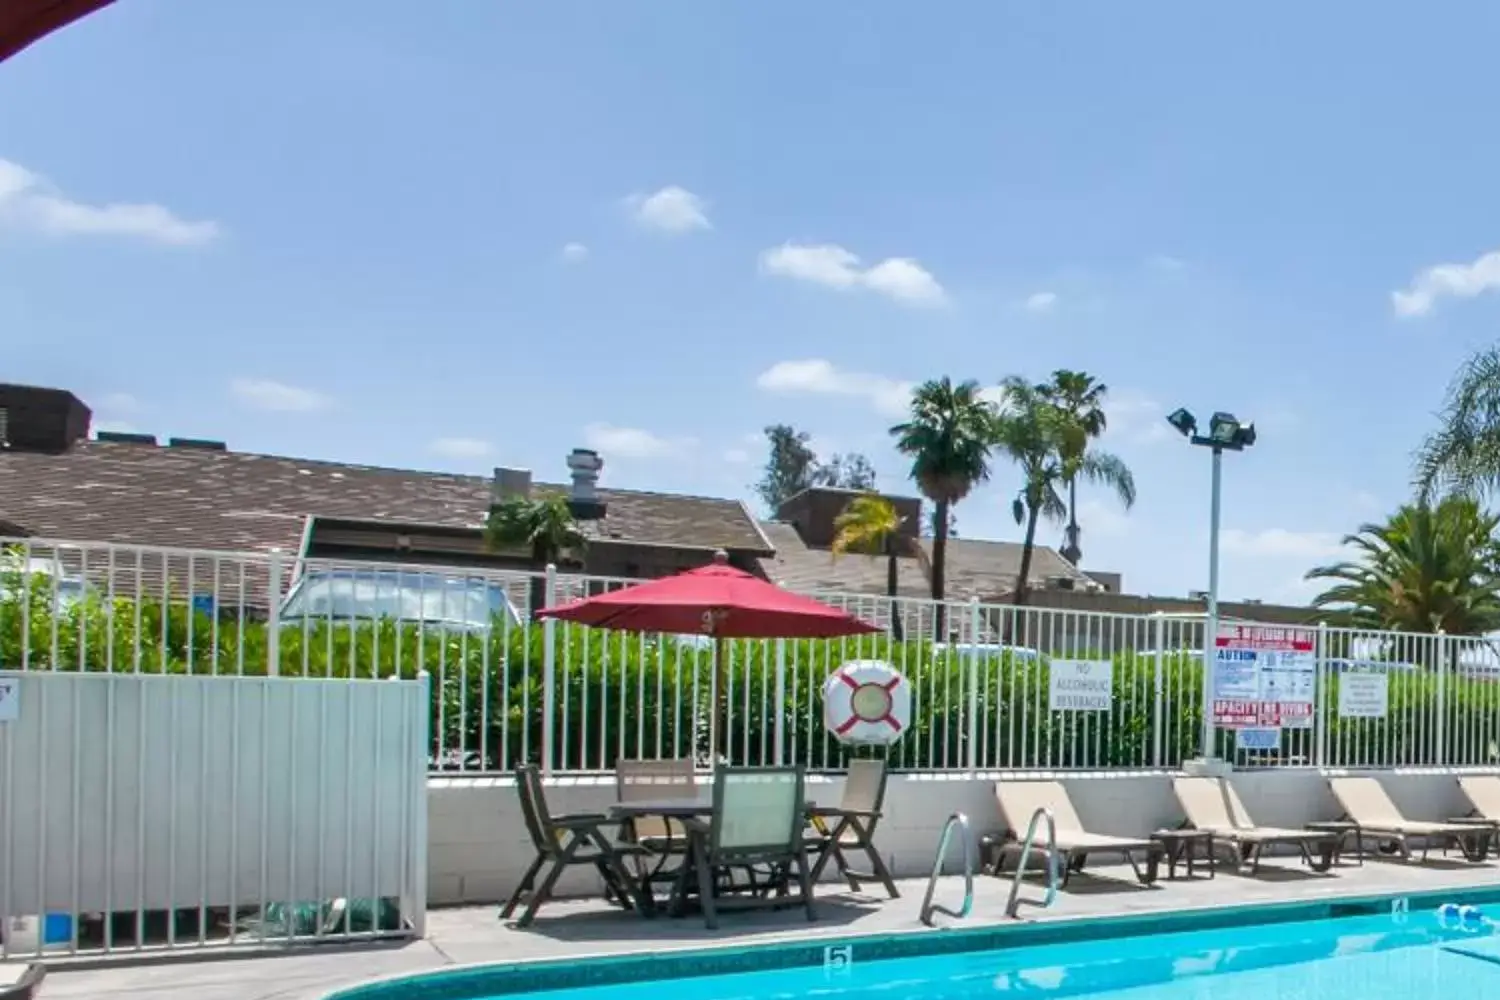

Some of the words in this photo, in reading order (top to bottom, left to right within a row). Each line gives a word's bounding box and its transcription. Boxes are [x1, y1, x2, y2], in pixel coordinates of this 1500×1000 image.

[1217, 650, 1257, 660] AUTION
[1075, 662, 1092, 674] NO
[1056, 678, 1108, 692] ALCOHOLIC
[1214, 700, 1257, 714] APACITY
[829, 946, 848, 966] 5
